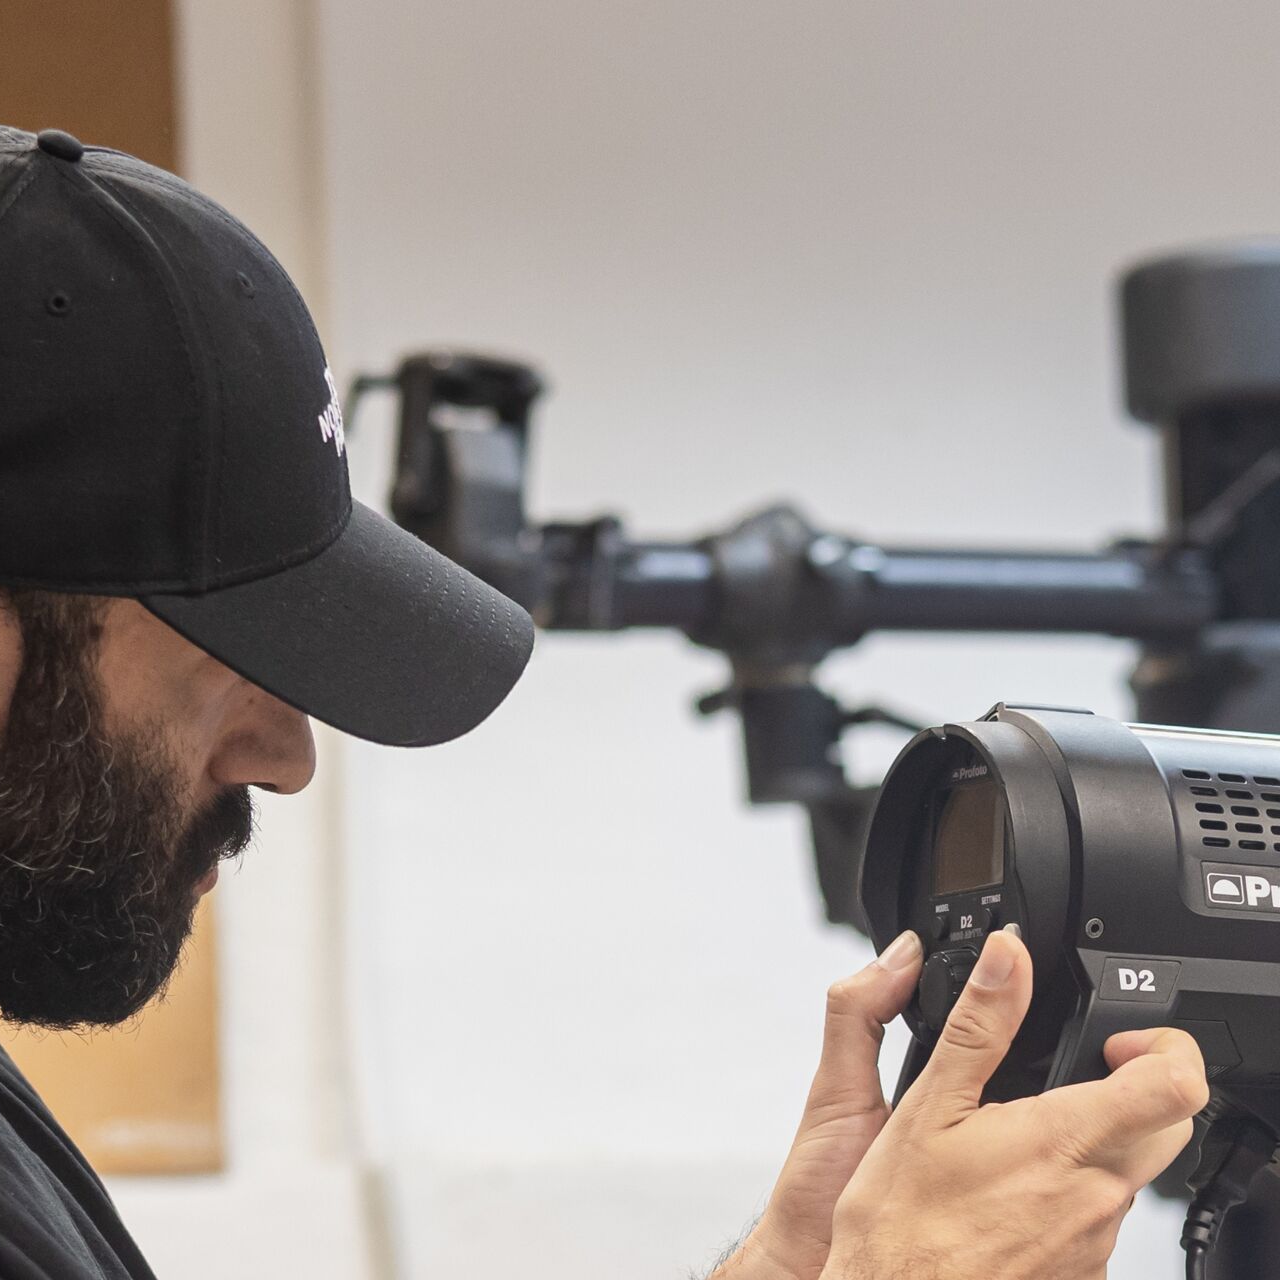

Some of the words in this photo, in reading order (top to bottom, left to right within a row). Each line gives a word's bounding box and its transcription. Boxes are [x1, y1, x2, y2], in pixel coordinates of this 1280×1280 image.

[960, 765, 987, 780] Profoto
[961, 915, 972, 929] D2
[1118, 968, 1156, 992] D2
